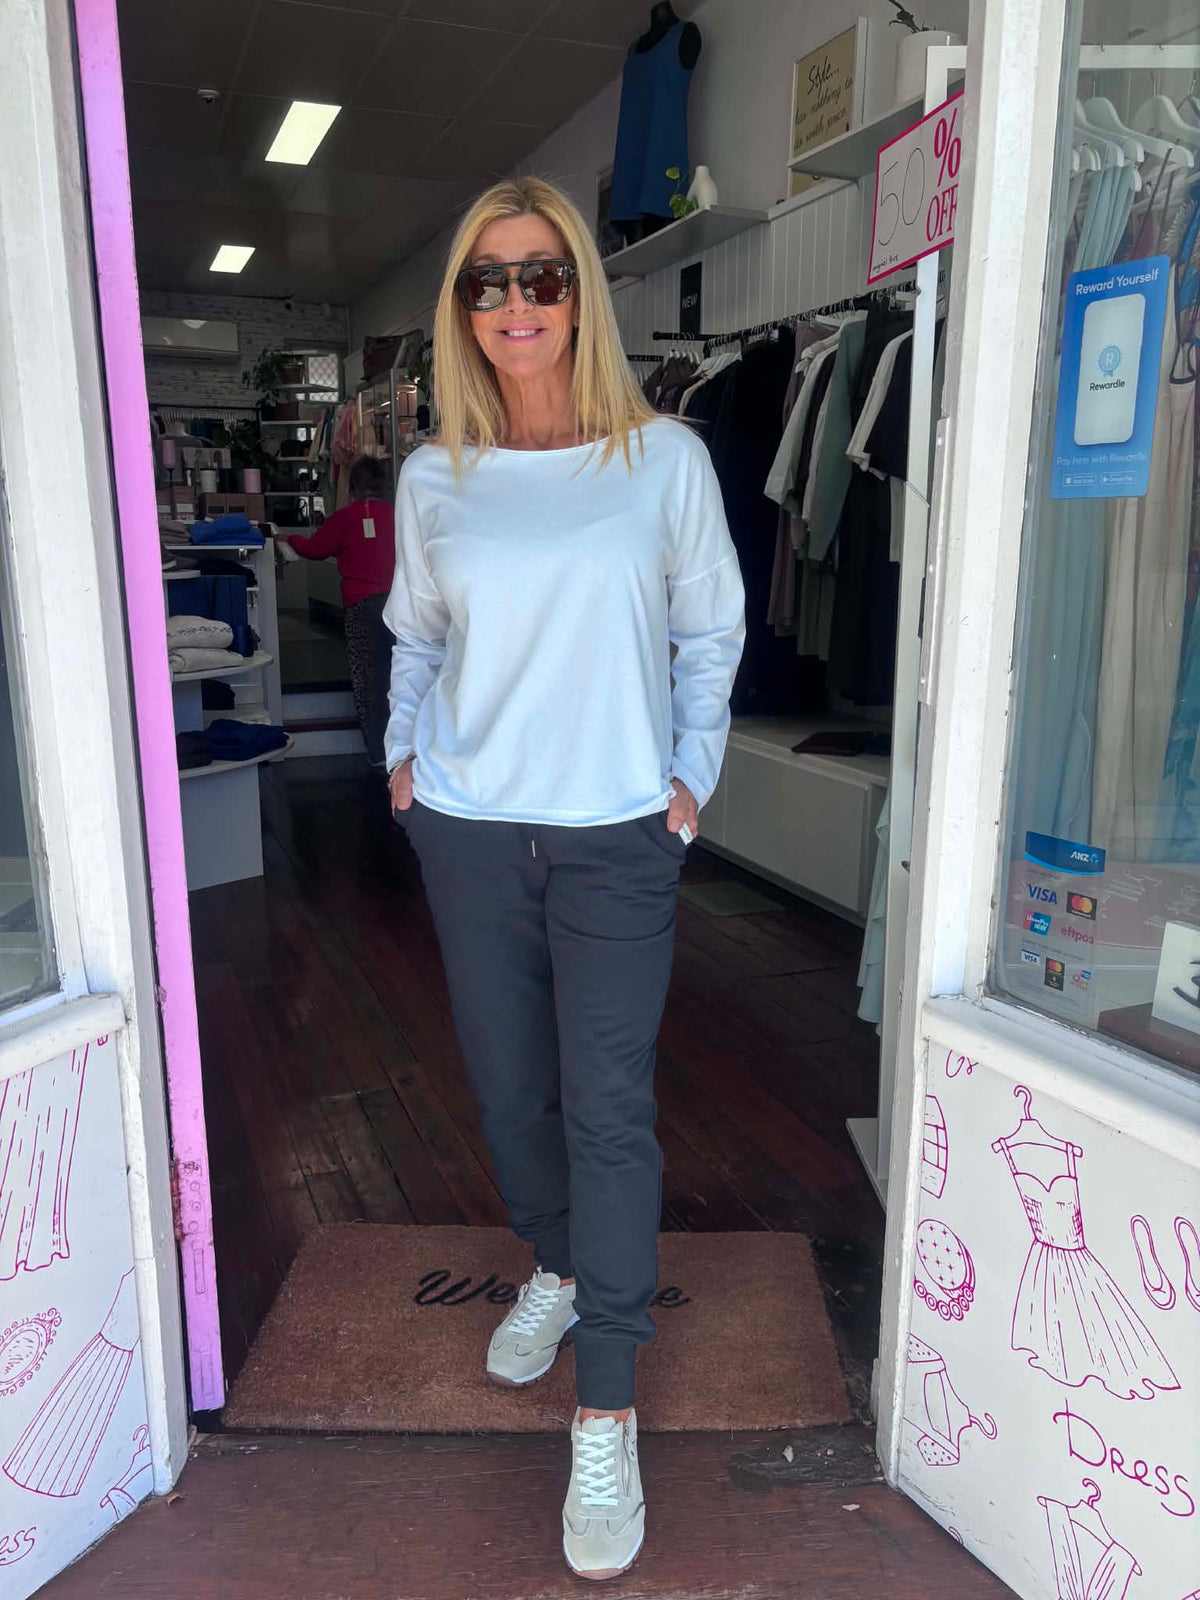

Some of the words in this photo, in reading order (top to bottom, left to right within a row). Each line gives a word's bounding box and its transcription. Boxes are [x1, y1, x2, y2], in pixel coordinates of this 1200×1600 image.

[878, 147, 926, 246] 50
[926, 183, 958, 242] OFF
[1075, 275, 1114, 295] Reward
[1116, 268, 1160, 288] Yourself
[1089, 379, 1126, 391] Rewardle
[1056, 456, 1071, 467] Pay
[1070, 851, 1090, 863] ANZ
[1027, 883, 1058, 905] VISA
[1061, 926, 1095, 944] eftpos
[1024, 953, 1038, 963] VISA
